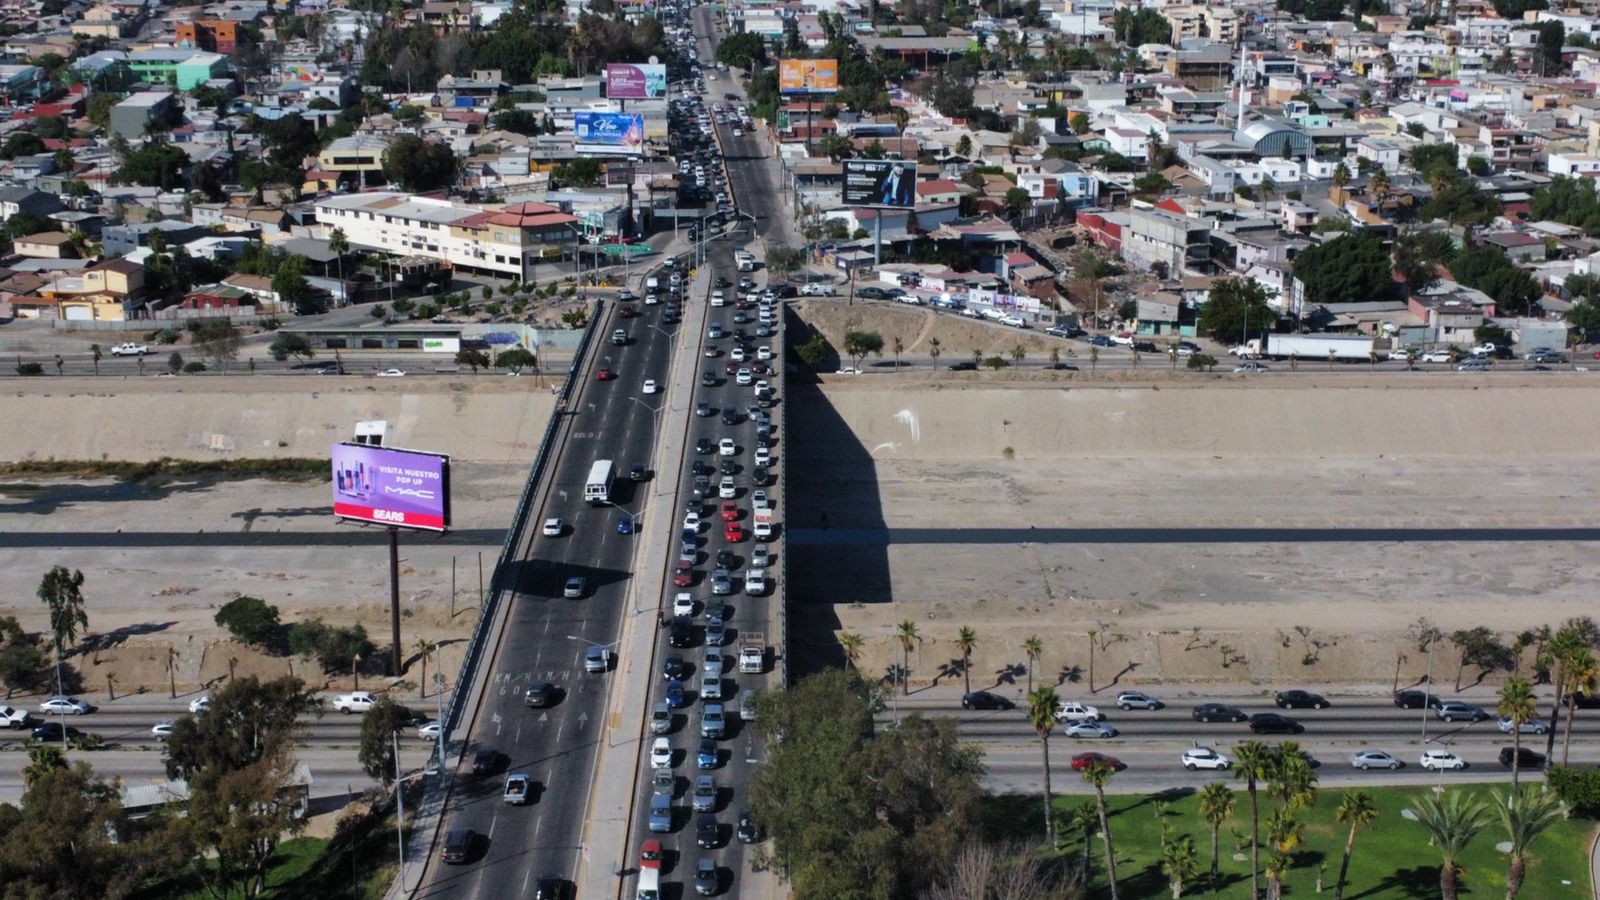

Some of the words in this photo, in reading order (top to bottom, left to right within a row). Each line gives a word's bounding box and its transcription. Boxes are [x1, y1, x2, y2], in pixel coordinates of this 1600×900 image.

[379, 466, 403, 475] VISITA
[404, 469, 439, 480] NUESTRO
[396, 476, 411, 484] POP
[373, 509, 405, 522] SEARS
[499, 685, 521, 697] 60
